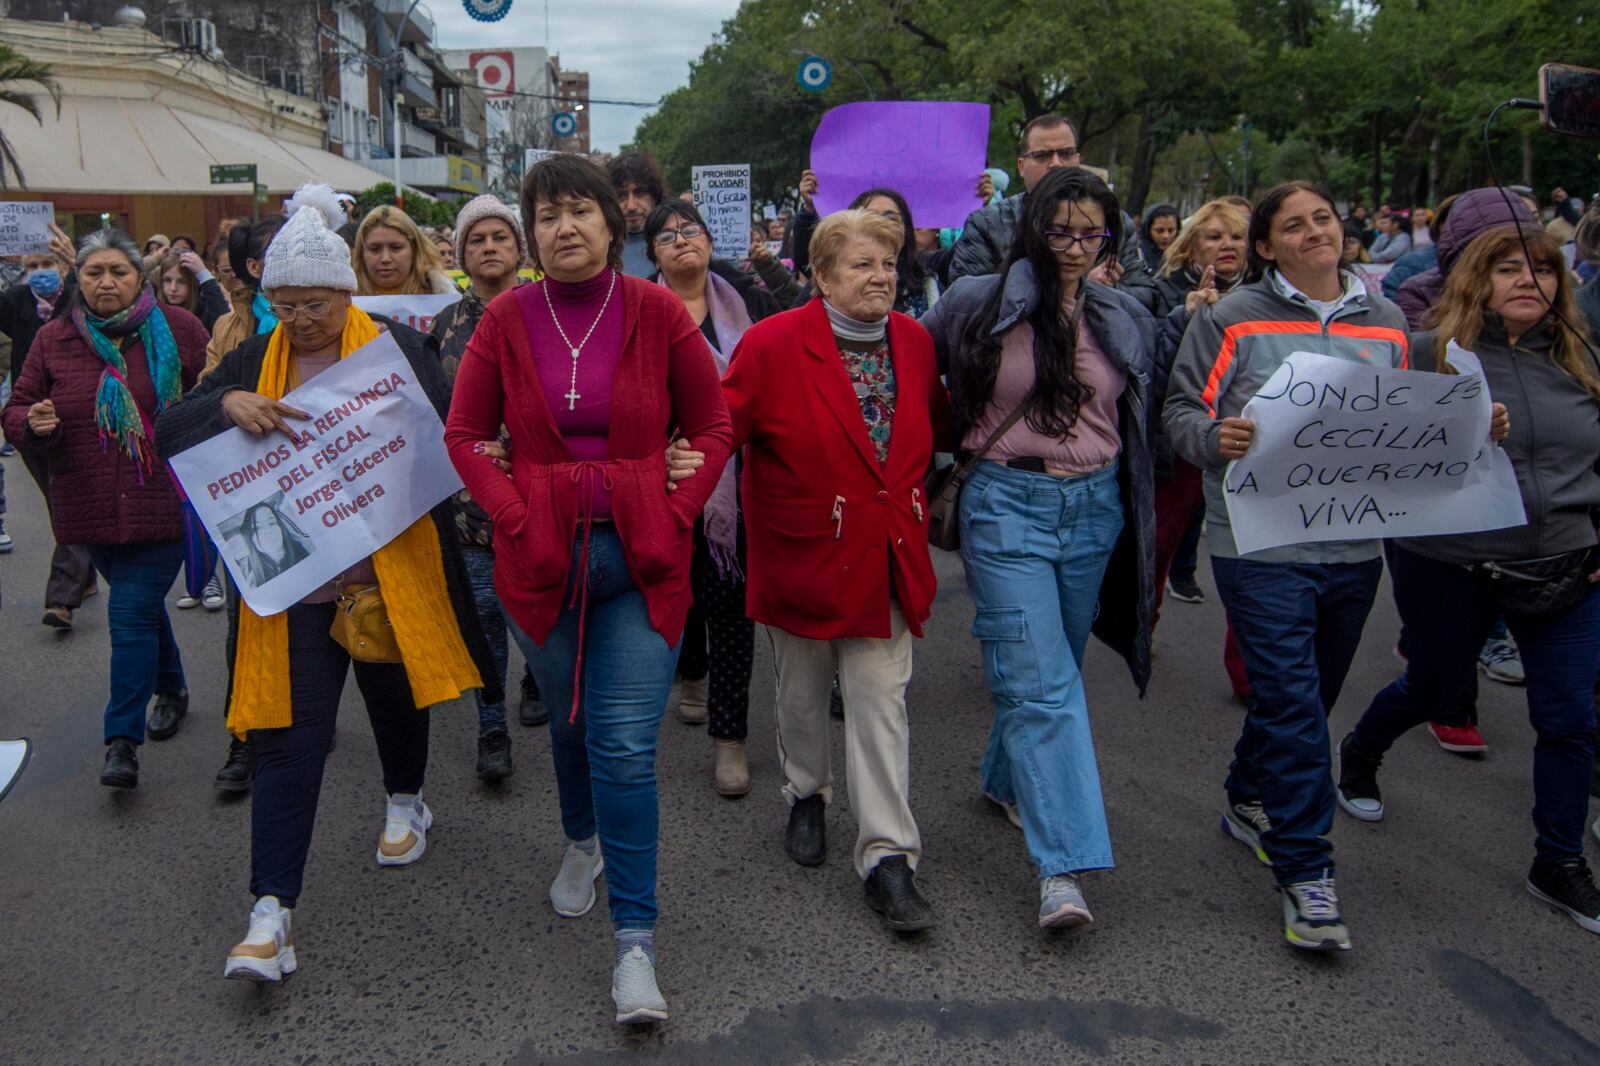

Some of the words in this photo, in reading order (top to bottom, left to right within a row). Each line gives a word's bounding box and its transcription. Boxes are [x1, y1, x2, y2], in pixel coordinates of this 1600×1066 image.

[703, 170, 749, 178] PROHIBIDO
[206, 444, 292, 500] PEDIMOS
[313, 372, 407, 436] RENUNCIA
[277, 463, 314, 494] DEL
[311, 424, 371, 470] FISCAL
[295, 478, 343, 516] Jorge
[341, 434, 407, 483] Cáceres
[1286, 451, 1482, 488] QUEREMO
[321, 483, 386, 529] Olivera
